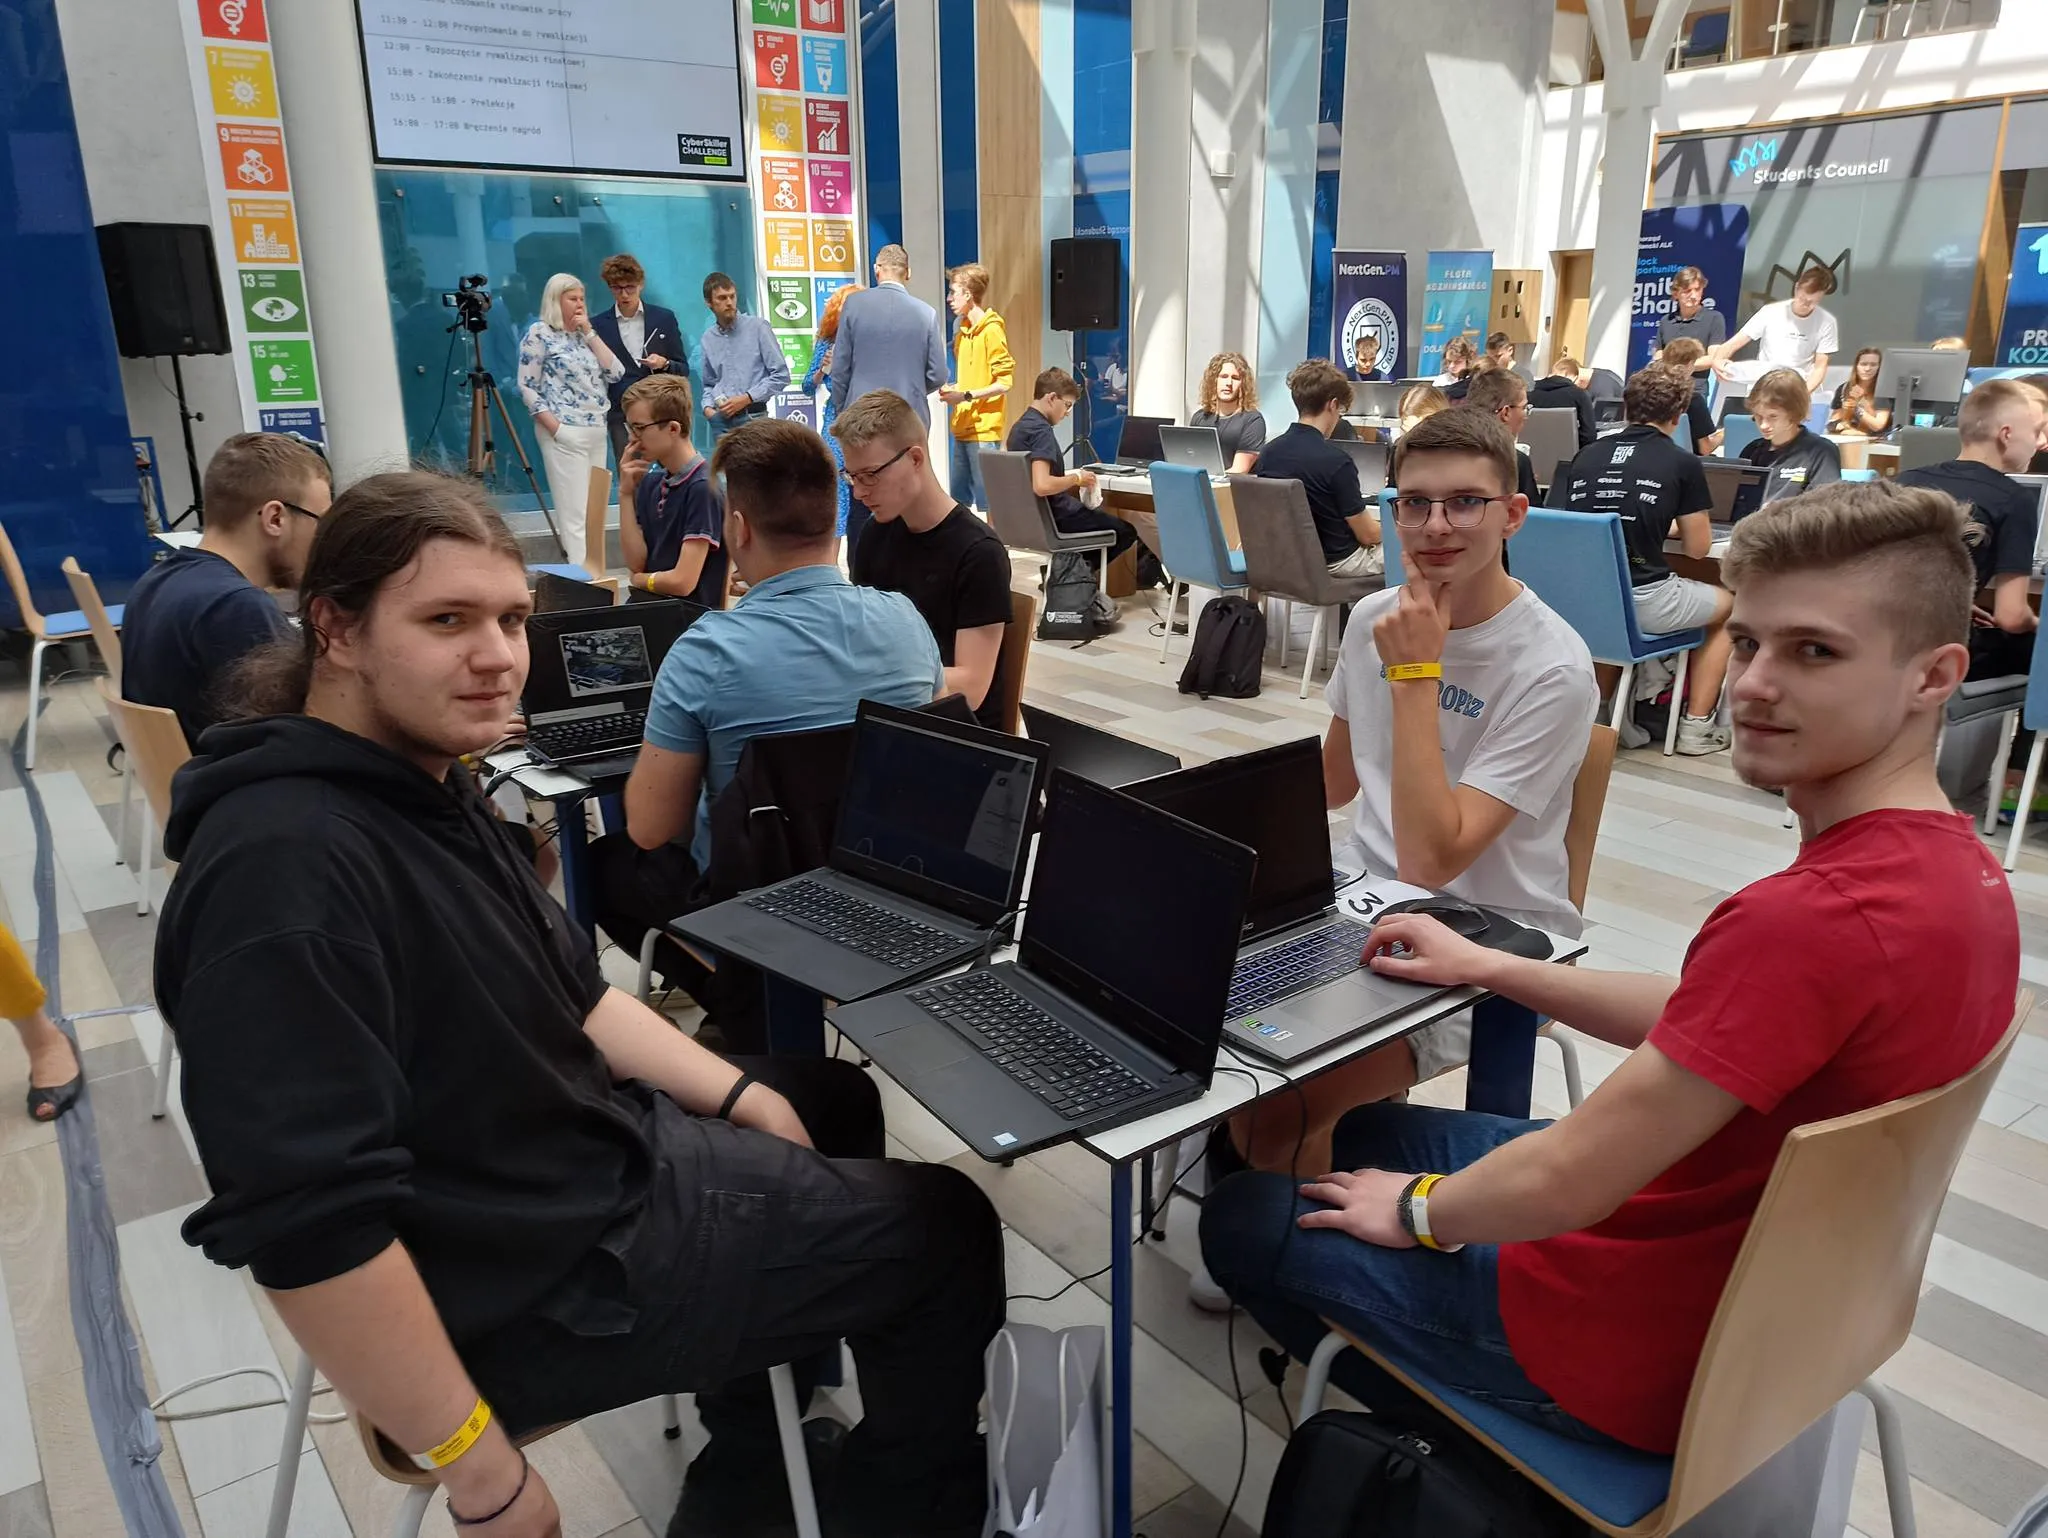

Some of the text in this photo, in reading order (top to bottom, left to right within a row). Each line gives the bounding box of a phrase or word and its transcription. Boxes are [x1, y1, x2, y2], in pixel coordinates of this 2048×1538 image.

[757, 34, 764, 48] 5
[209, 51, 218, 65] 7
[220, 127, 230, 143] 9
[681, 137, 728, 148] CyberSkiller
[682, 147, 727, 157] CHALLENGE
[811, 163, 820, 176] 10
[1753, 158, 1890, 185] Students Council
[231, 203, 243, 217] 11
[768, 221, 775, 234] 11
[1338, 263, 1400, 276] NextGen.PM
[1444, 269, 1472, 279] FLOTA
[241, 273, 256, 288] 13
[770, 280, 780, 293] 13
[816, 281, 825, 293] 14
[1632, 277, 1674, 301] gnit
[1349, 303, 1393, 327] NextGen.PM
[252, 344, 267, 359] 15
[777, 394, 786, 407] 17
[263, 413, 276, 427] 17
